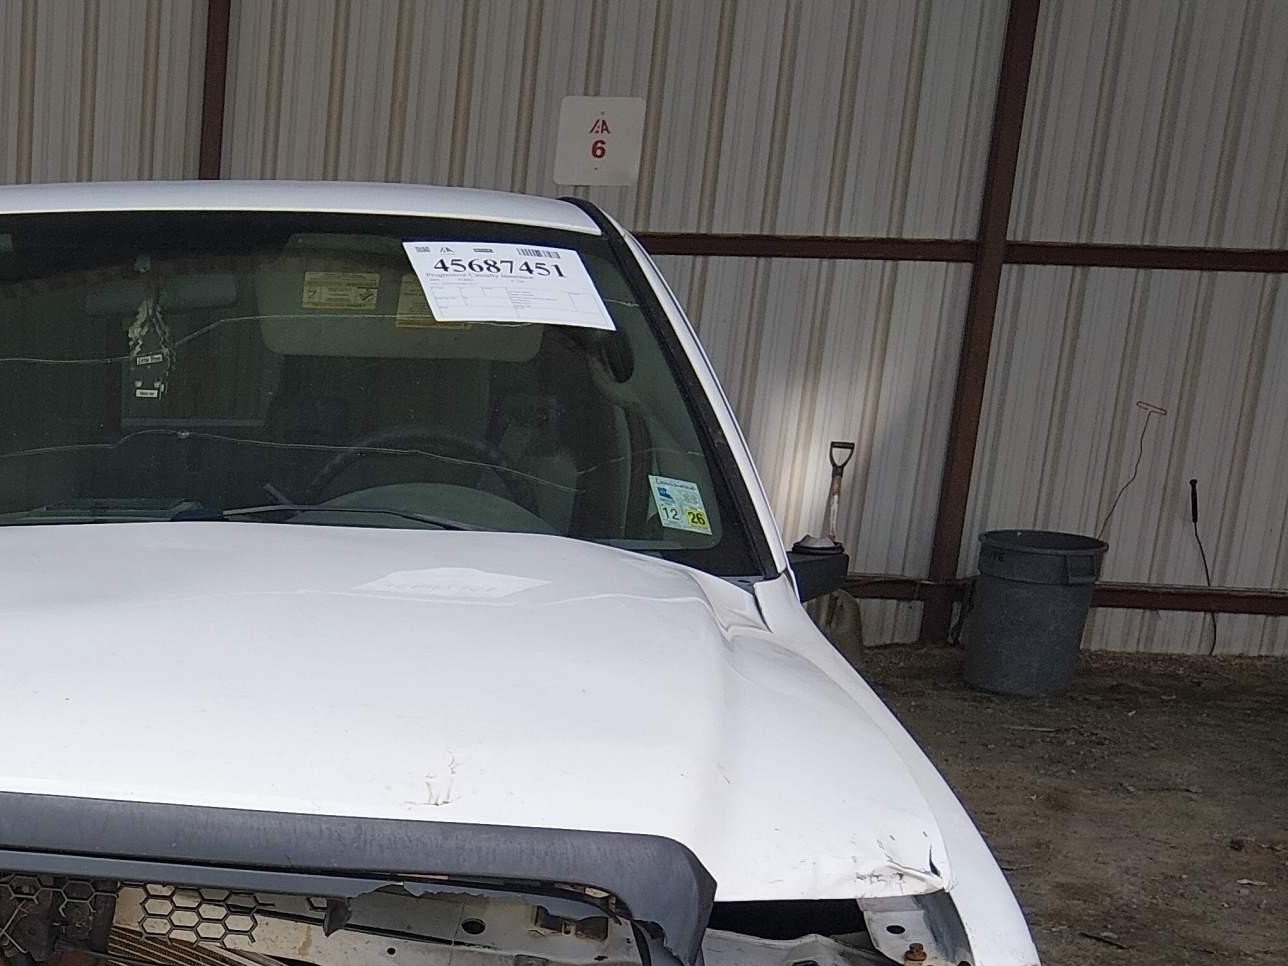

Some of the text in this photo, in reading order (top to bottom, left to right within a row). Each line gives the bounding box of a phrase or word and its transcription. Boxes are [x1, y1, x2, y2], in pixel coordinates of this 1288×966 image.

[591, 139, 606, 159] 6
[433, 258, 567, 278] 45687451
[662, 507, 706, 526] 12 26
